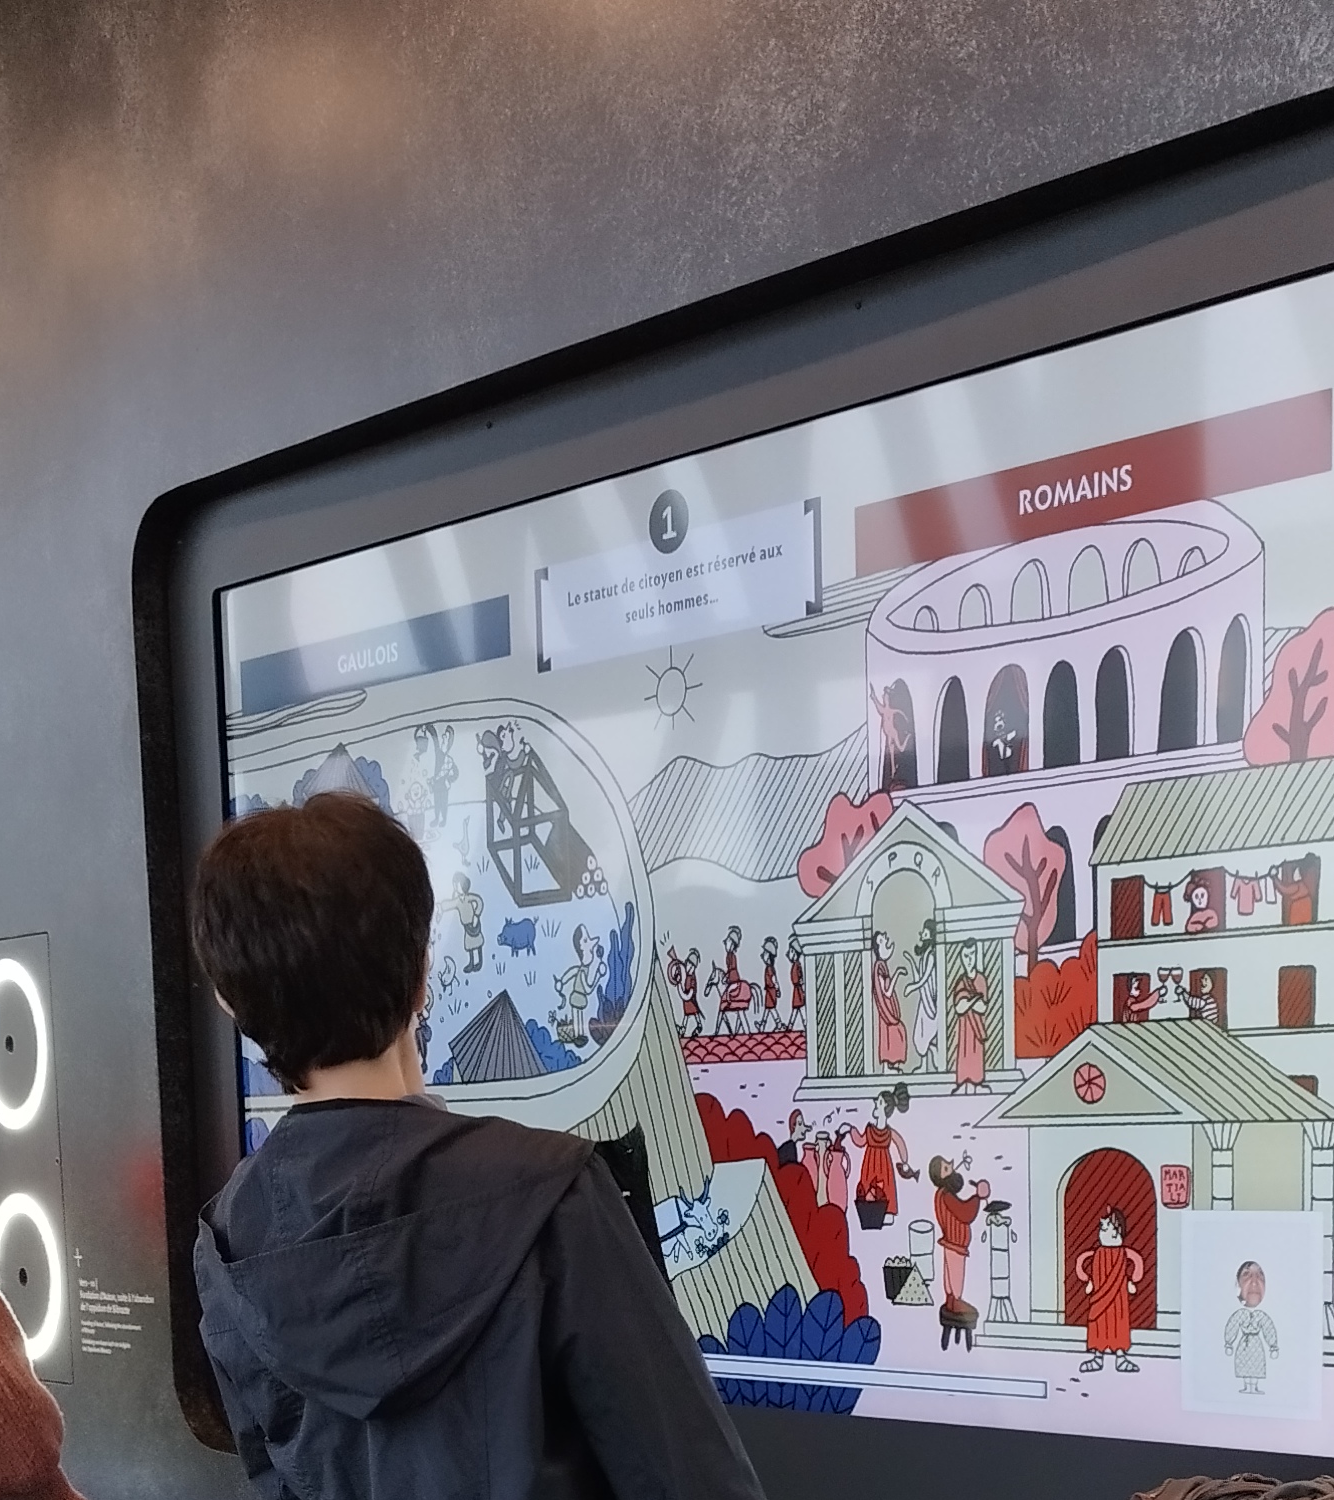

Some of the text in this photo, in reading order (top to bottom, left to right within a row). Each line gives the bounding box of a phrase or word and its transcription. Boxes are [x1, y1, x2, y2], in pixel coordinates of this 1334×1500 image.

[1019, 464, 1133, 515] ROMAINS
[662, 505, 677, 539] 1
[567, 544, 783, 607] Le statut de citoyen est réservé aux
[625, 602, 655, 623] seuls
[337, 642, 398, 674] GAULOIS
